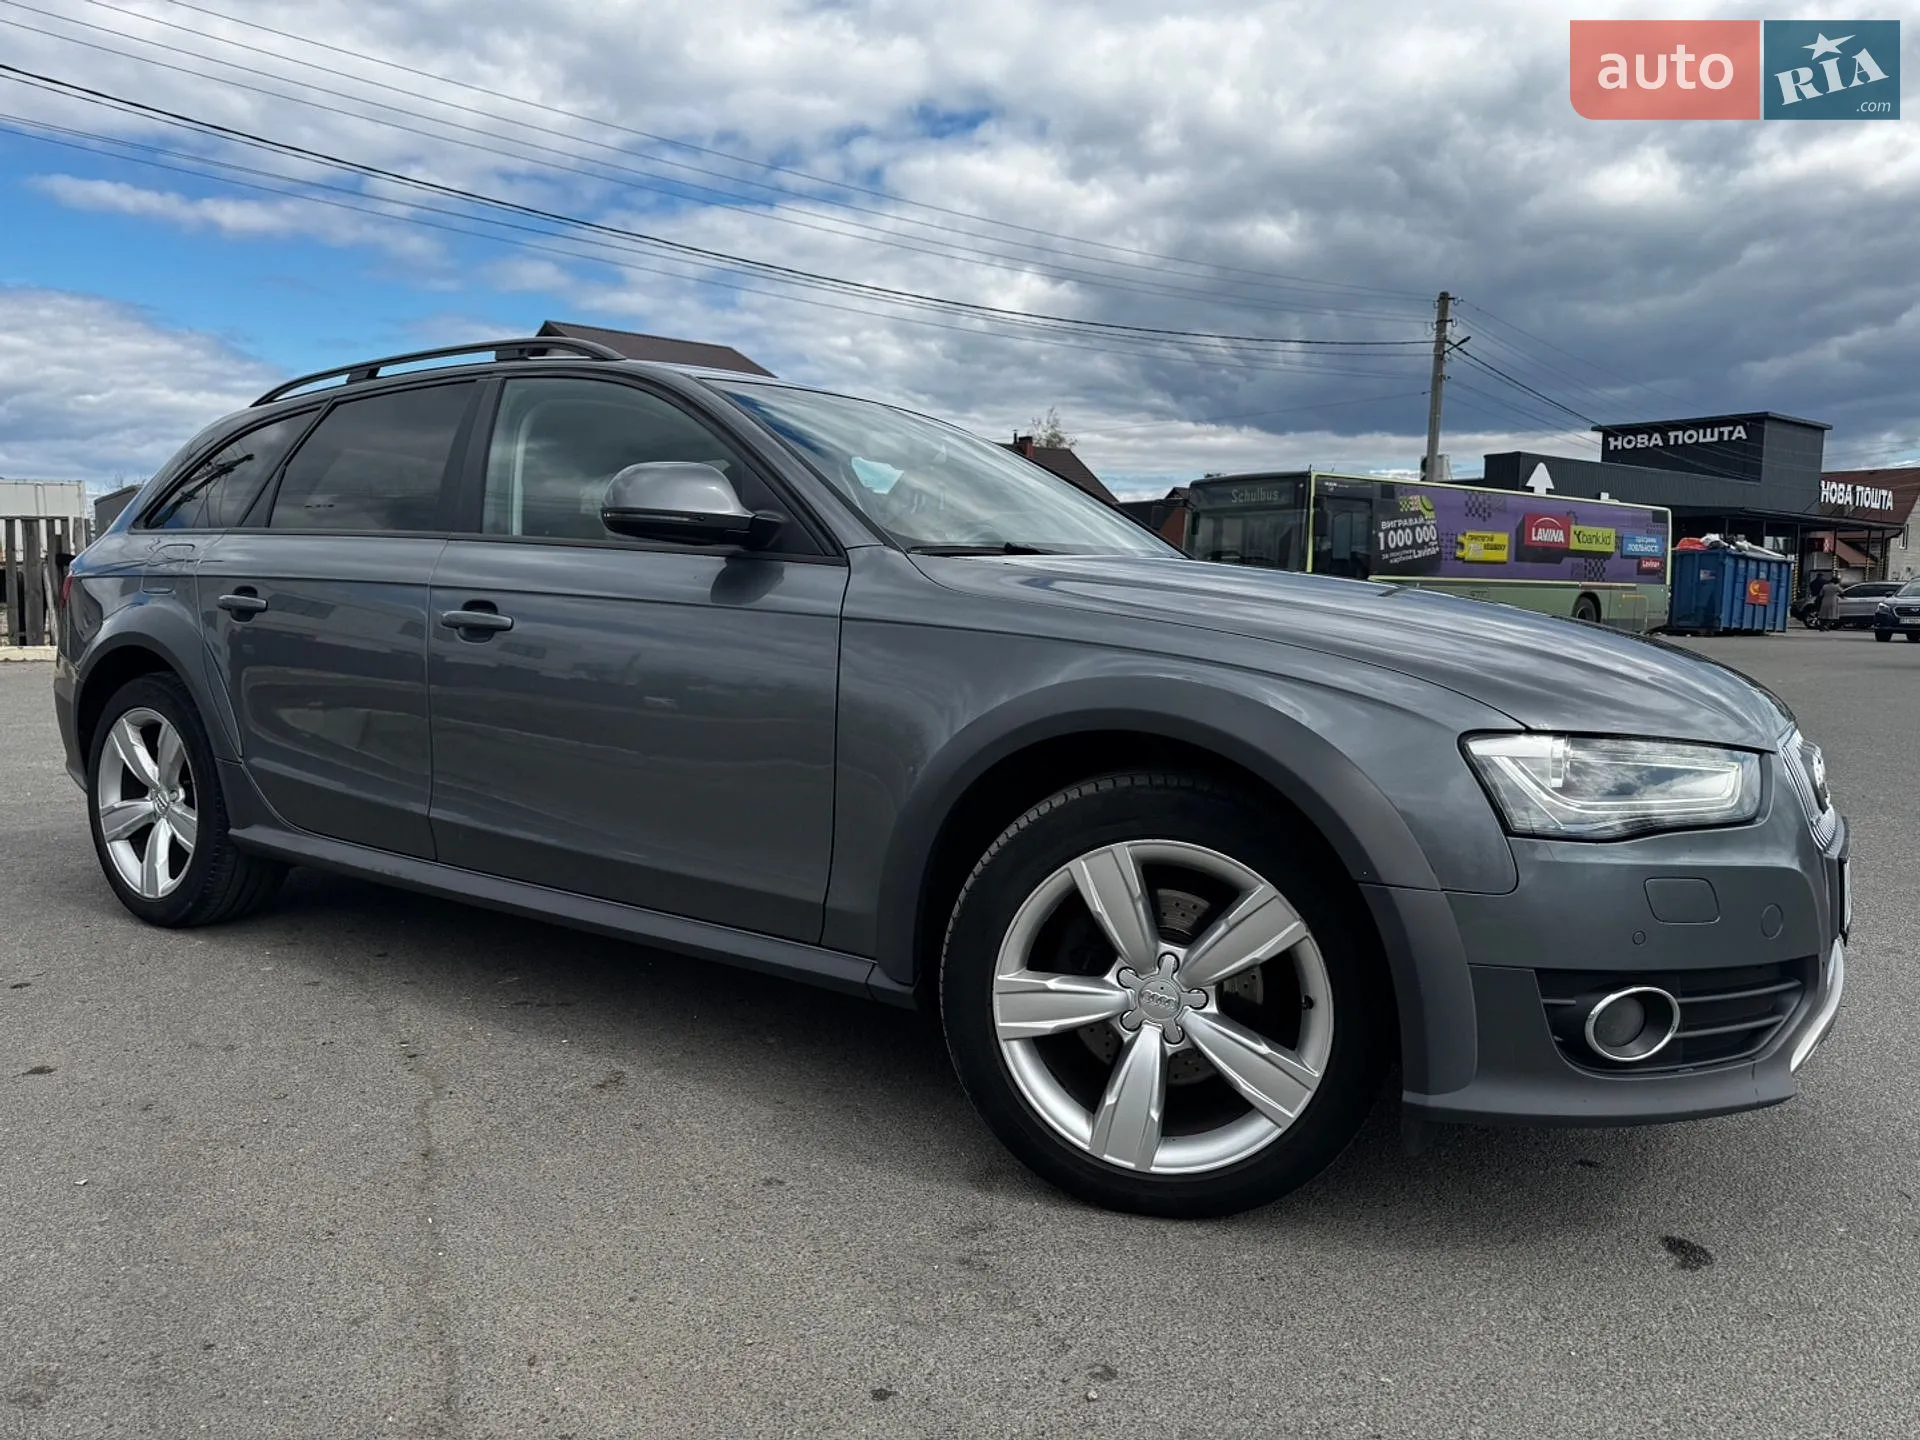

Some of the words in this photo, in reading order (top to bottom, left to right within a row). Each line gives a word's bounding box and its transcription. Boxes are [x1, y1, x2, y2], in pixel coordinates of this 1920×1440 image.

[1608, 433, 1663, 451] НОВА
[1668, 425, 1747, 445] ПОШТА
[1231, 487, 1280, 503] Schulbus
[1821, 480, 1853, 505] НОВА
[1855, 485, 1894, 511] ПОШТА
[1531, 527, 1565, 543] LAVINA
